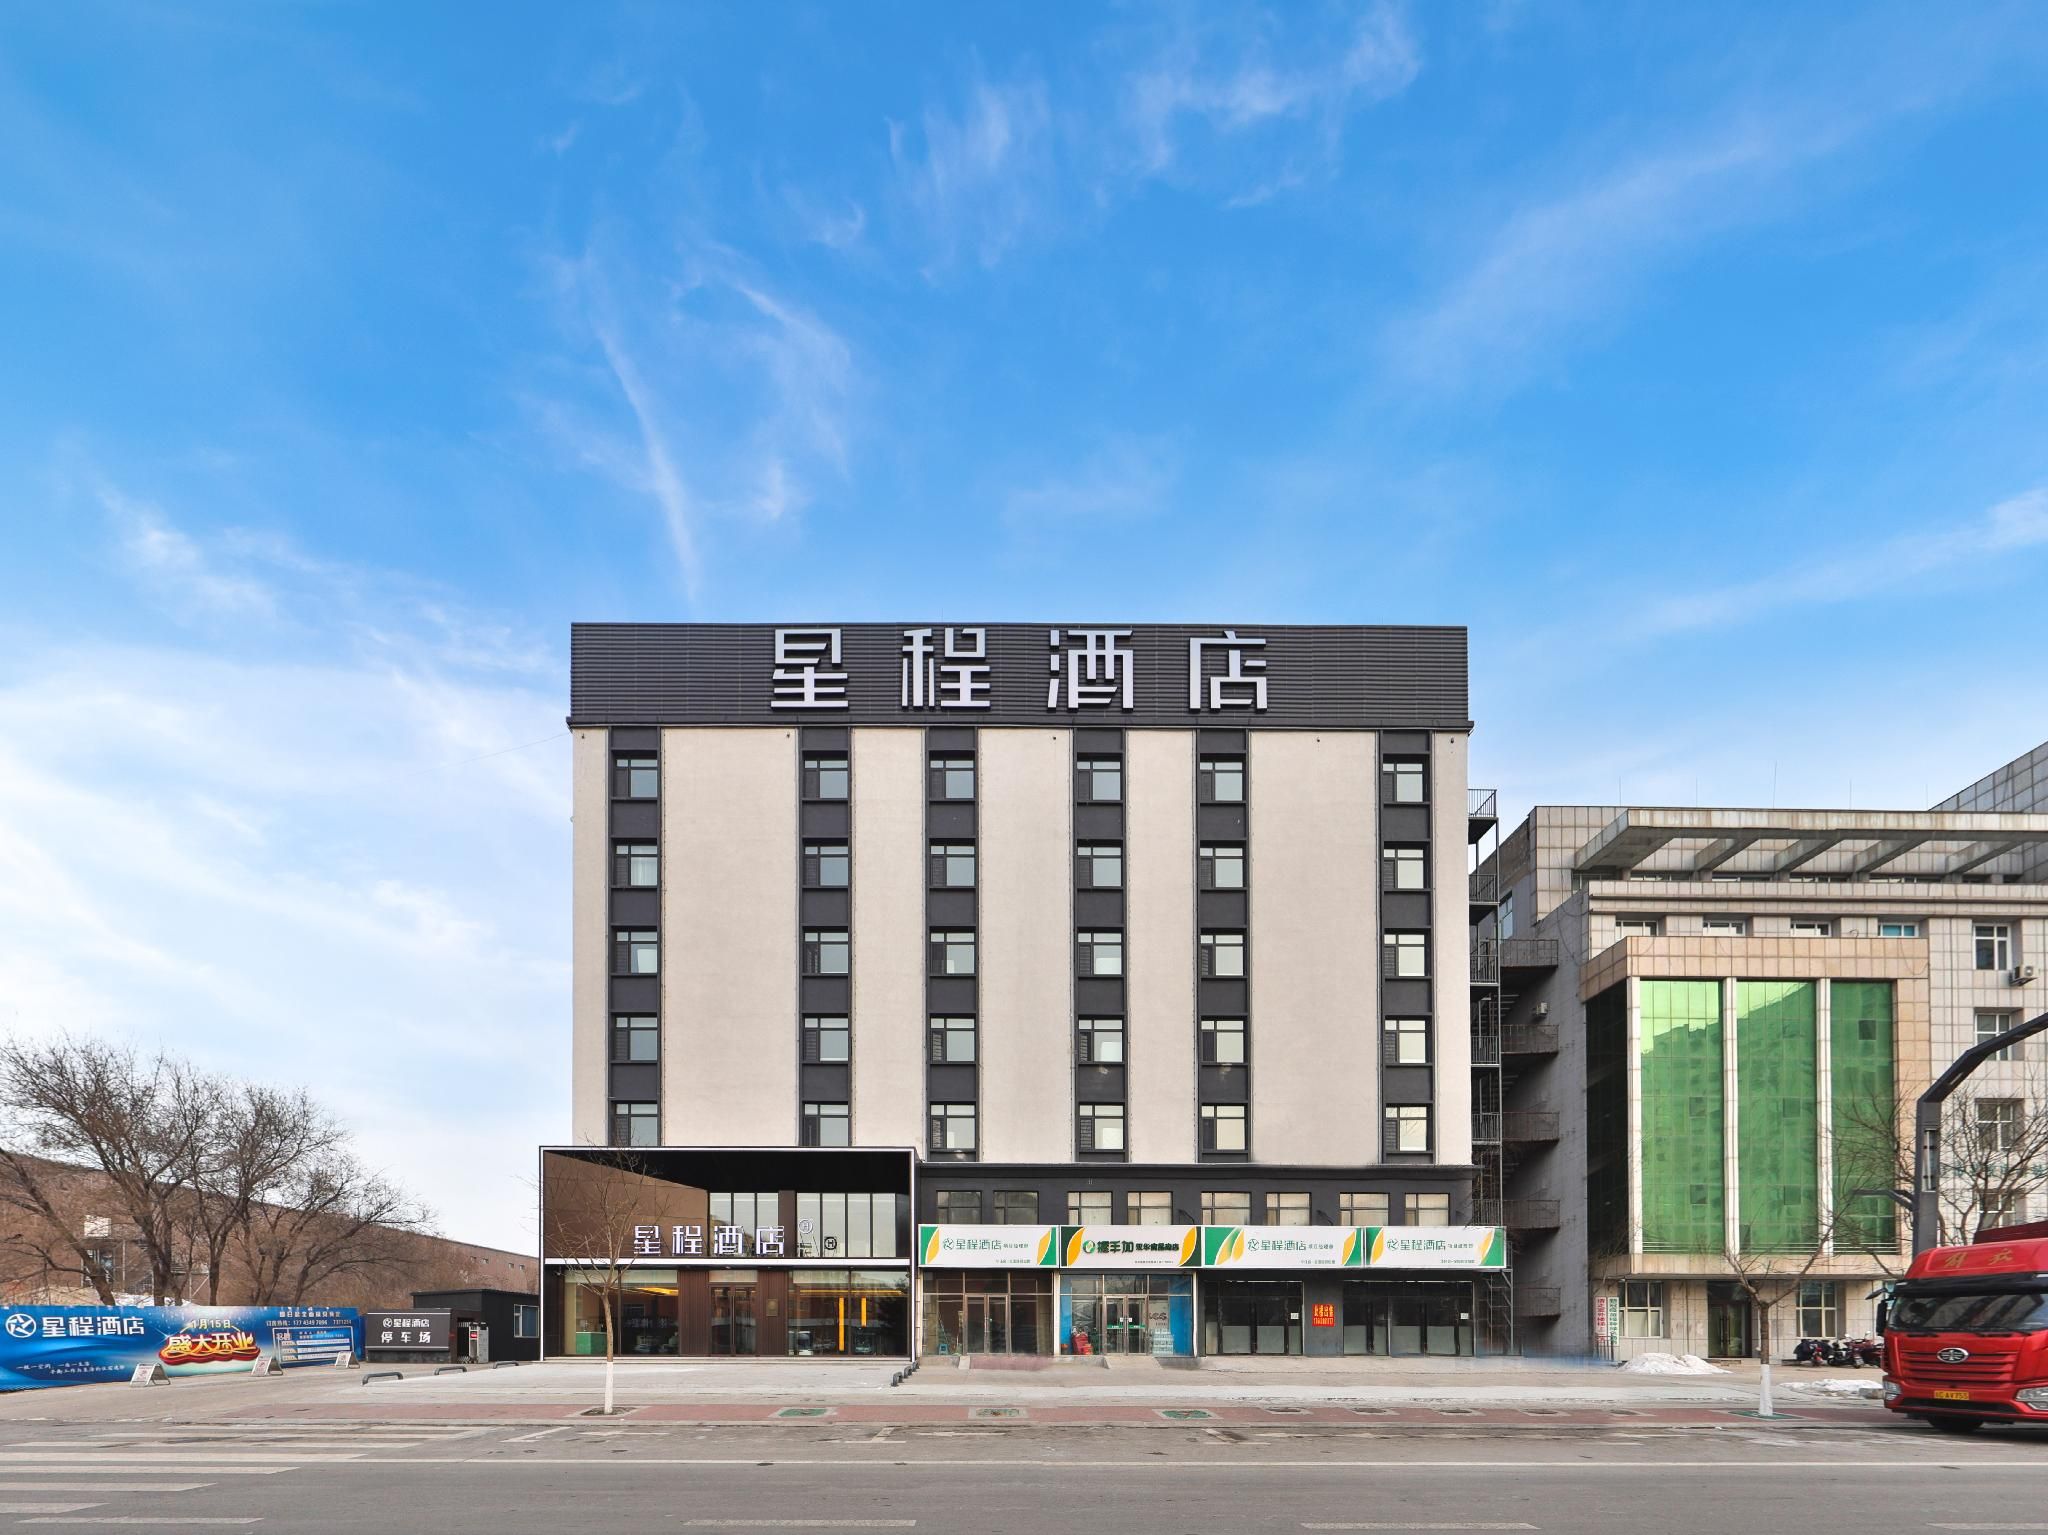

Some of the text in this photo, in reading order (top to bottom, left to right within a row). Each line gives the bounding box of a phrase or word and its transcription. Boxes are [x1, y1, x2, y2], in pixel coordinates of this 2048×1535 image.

[770, 627, 1270, 711] 星程酒店
[633, 1225, 786, 1256] 星程酒店
[955, 1238, 1002, 1251] 星程酒店
[1260, 1239, 1307, 1251] 星程酒店
[1400, 1239, 1446, 1251] 星程酒店
[41, 1316, 145, 1338] 星程酒店
[393, 1319, 430, 1328] 星程酒店
[168, 1331, 257, 1352] 盛大开业
[381, 1331, 432, 1345] 停车场
